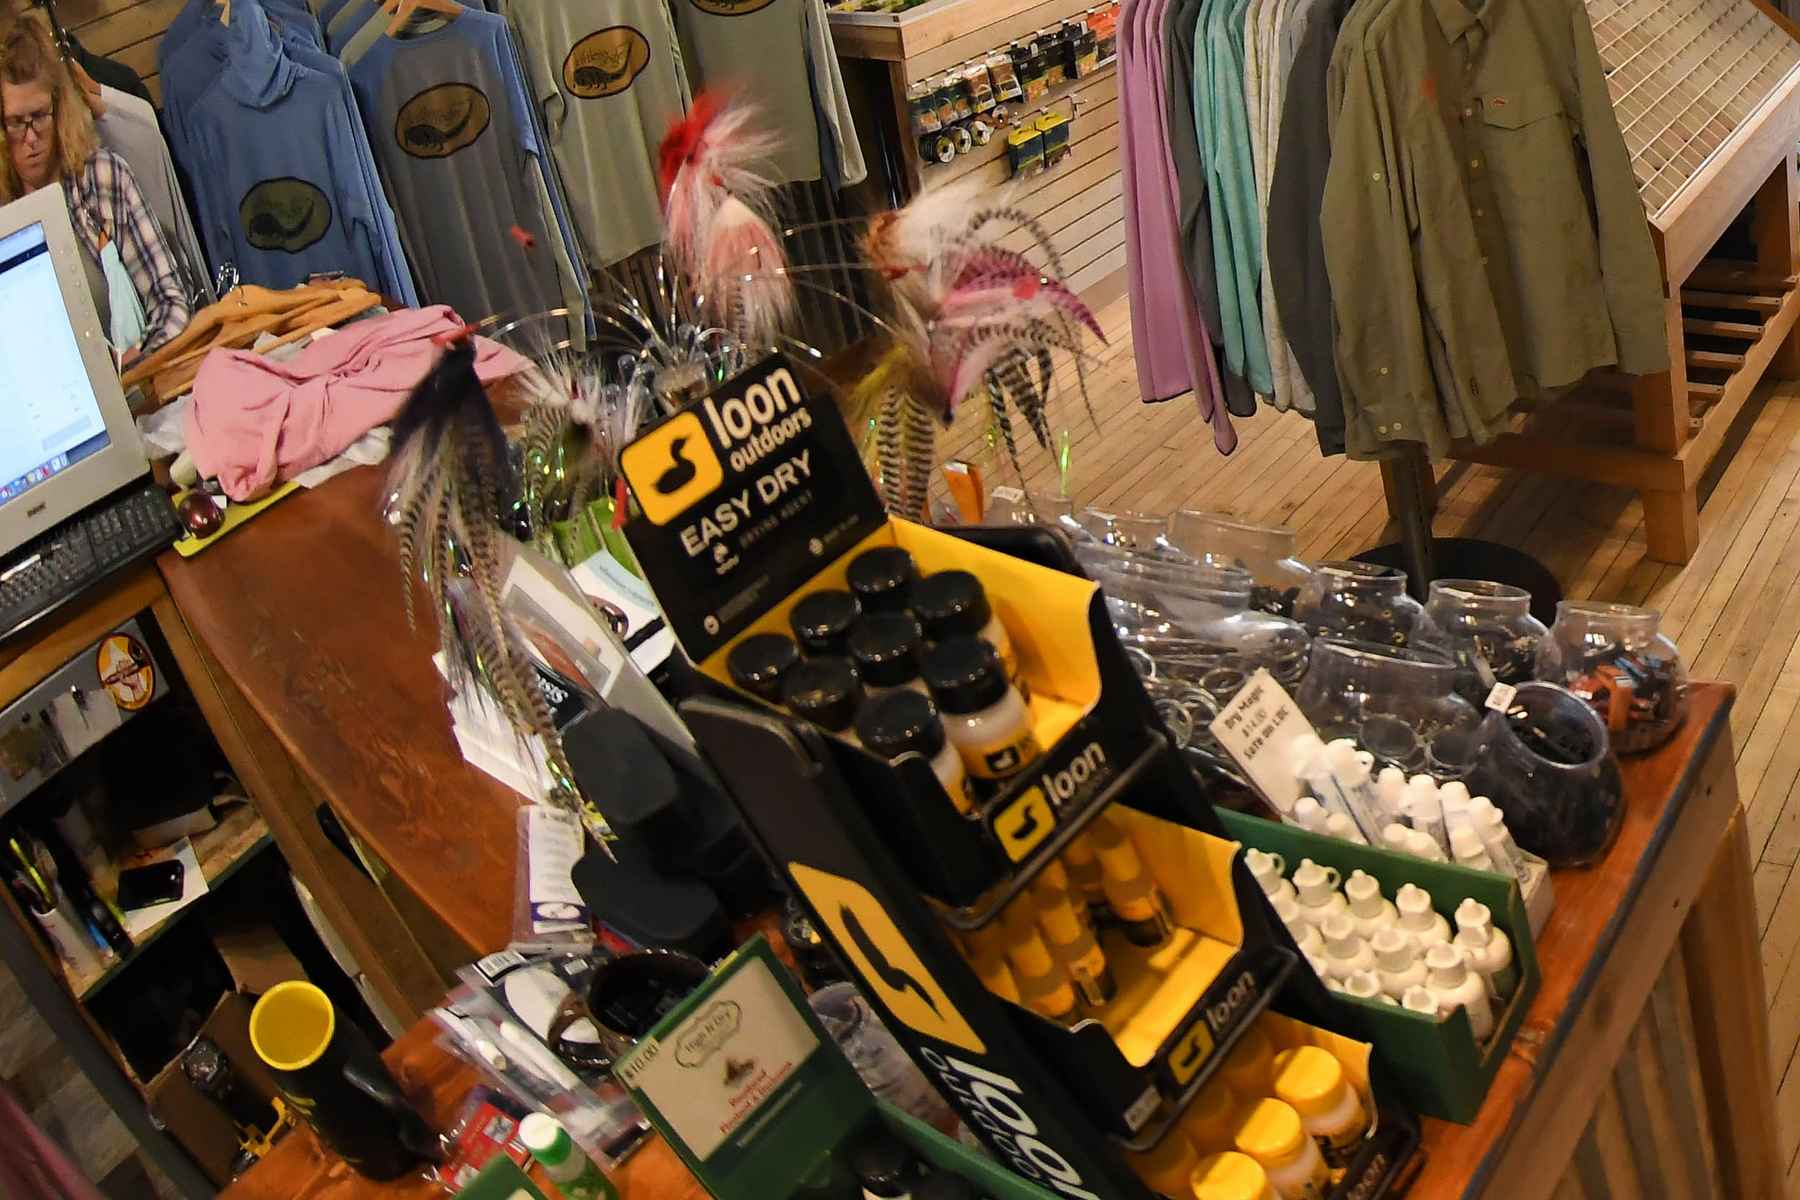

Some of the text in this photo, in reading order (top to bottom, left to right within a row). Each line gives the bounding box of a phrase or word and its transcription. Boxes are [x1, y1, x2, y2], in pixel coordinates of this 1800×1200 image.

[704, 367, 802, 450] loon
[730, 406, 813, 473] outdoors
[679, 487, 752, 558] EASY
[756, 448, 812, 504] DRY
[1044, 739, 1107, 805] loon
[1205, 972, 1256, 1033] loon
[920, 1046, 1046, 1186] outdoo
